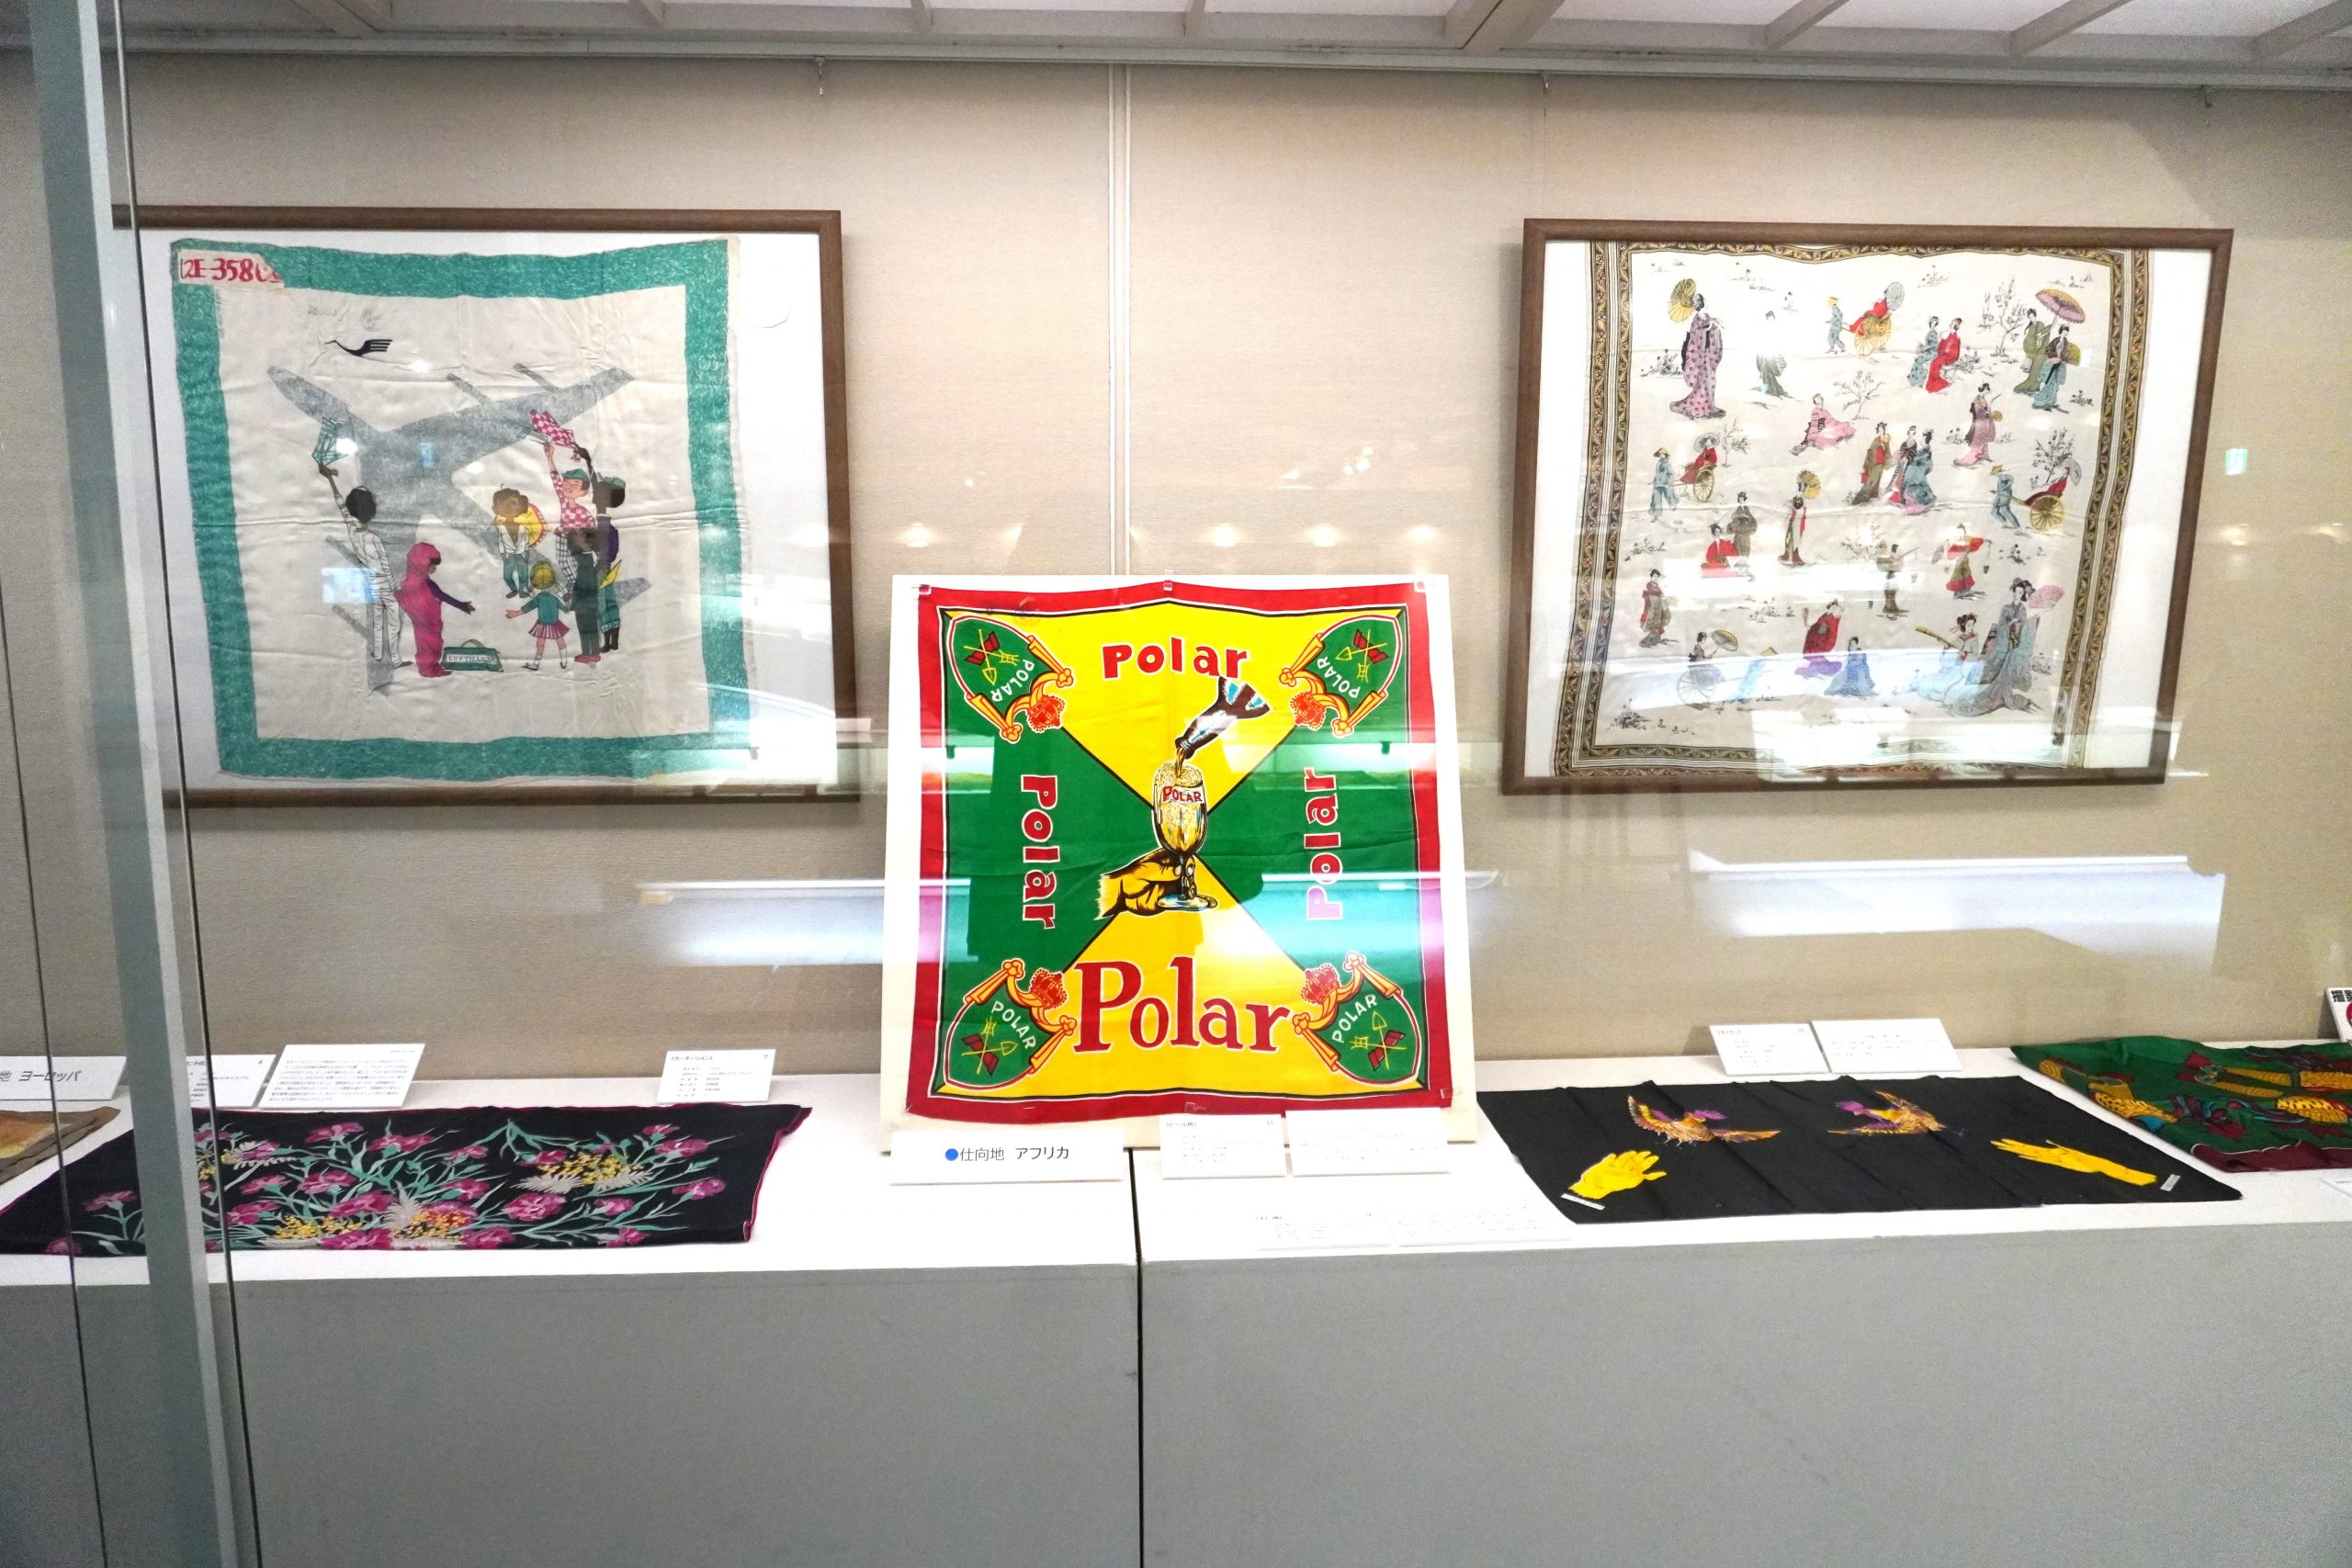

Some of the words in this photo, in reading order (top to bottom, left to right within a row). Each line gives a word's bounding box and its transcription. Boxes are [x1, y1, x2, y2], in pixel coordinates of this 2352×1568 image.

[990, 660, 1035, 702] POLAR
[1102, 636, 1249, 680] Polar
[1317, 656, 1361, 699] POLAR
[1162, 785, 1203, 802] POLAR
[1021, 774, 1060, 930] Polar
[1304, 767, 1343, 920] Polar
[991, 1000, 1036, 1049] POLAR
[1072, 955, 1291, 1053] Polar
[1331, 994, 1378, 1043] POLAR
[960, 1147, 1005, 1162] 仕向地
[1015, 1146, 1069, 1160] アフリカ
